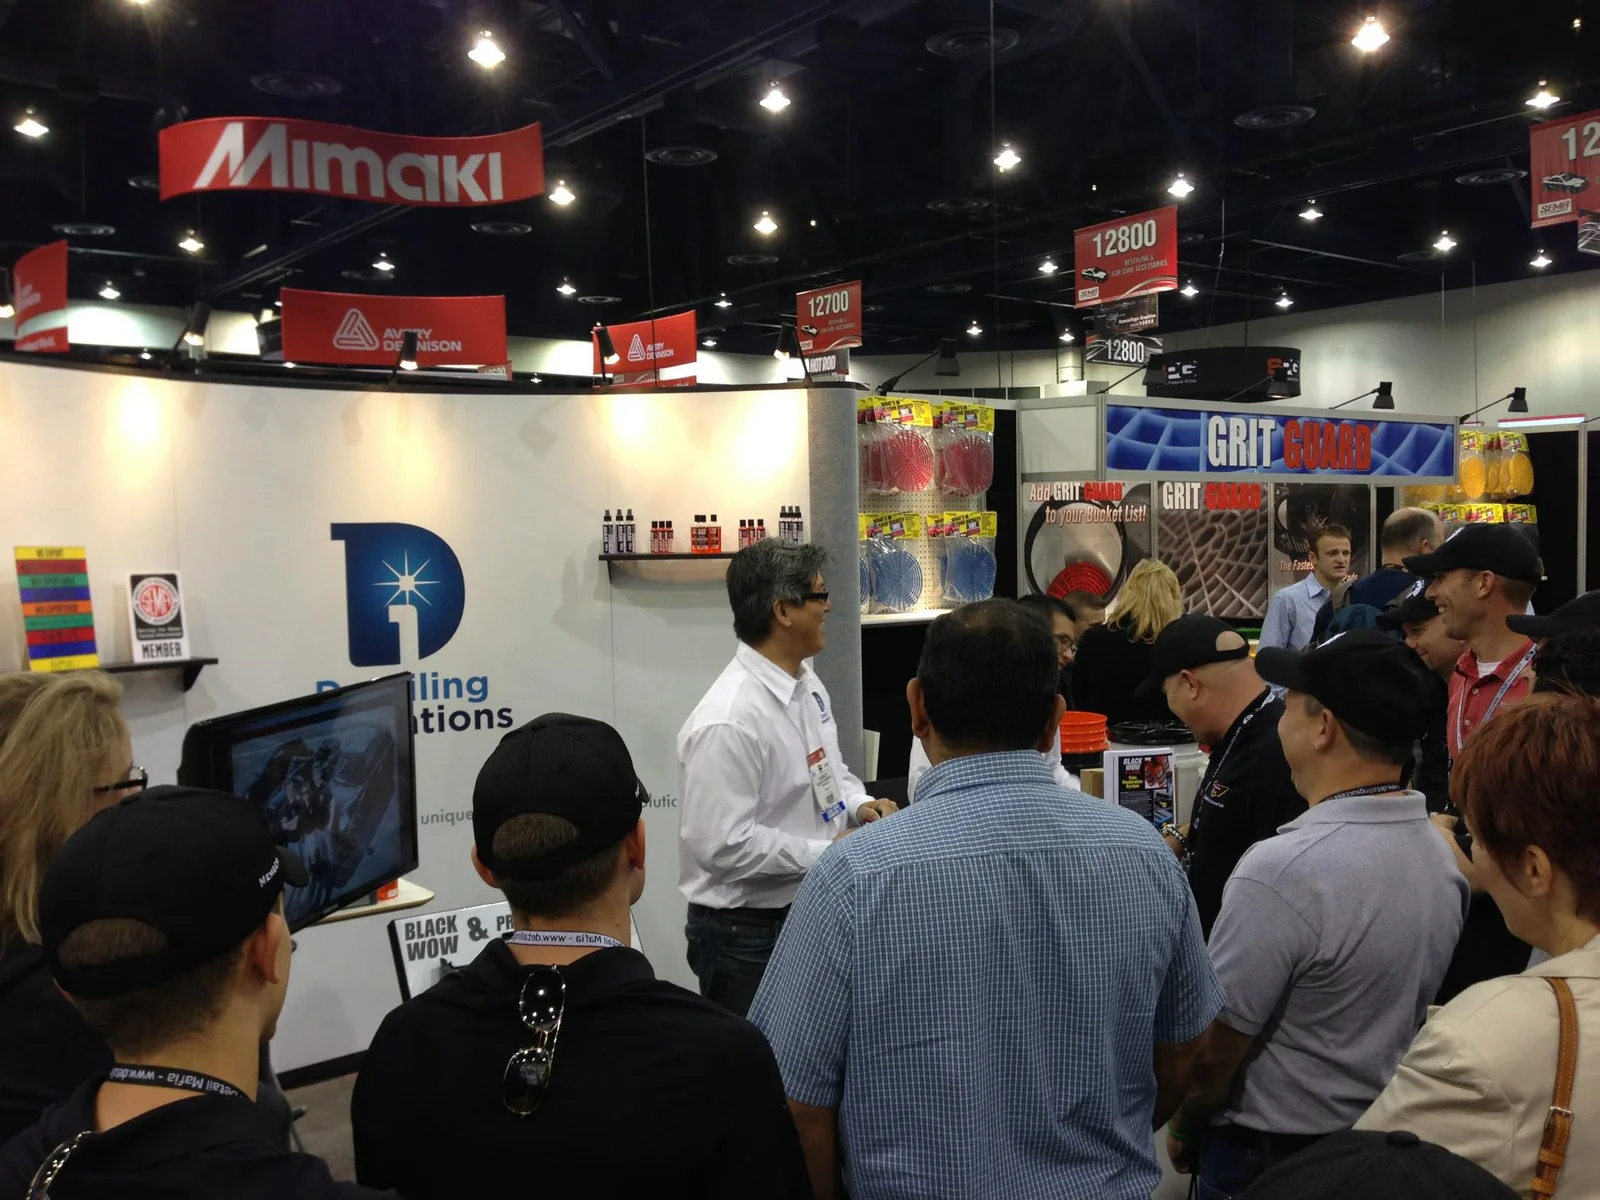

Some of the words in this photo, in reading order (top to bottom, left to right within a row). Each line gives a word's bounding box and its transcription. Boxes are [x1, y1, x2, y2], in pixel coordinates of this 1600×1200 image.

[1093, 220, 1157, 258] 12800
[808, 290, 849, 317] 12700
[383, 340, 462, 351] DENISON
[384, 328, 432, 339] AVRY
[1106, 339, 1145, 363] 12800
[1208, 415, 1276, 468] GRIT
[1284, 420, 1373, 471] GUARD
[1029, 483, 1050, 505] Add
[1053, 481, 1081, 501] GRIT
[1084, 481, 1124, 501] GUARD
[1163, 481, 1201, 510] GRIT
[1205, 482, 1262, 511] GUARD
[1045, 507, 1057, 524] to
[1059, 507, 1083, 527] your
[1085, 505, 1123, 523] Bucket
[1125, 506, 1147, 522] List!
[1280, 561, 1291, 571] The
[1293, 560, 1315, 571] Fastes
[141, 642, 182, 659] MEMBER
[420, 808, 474, 827] unique
[405, 915, 457, 941] BLACK
[467, 916, 489, 942] &
[407, 935, 459, 962] WOW
[167, 1072, 204, 1090] Mafia
